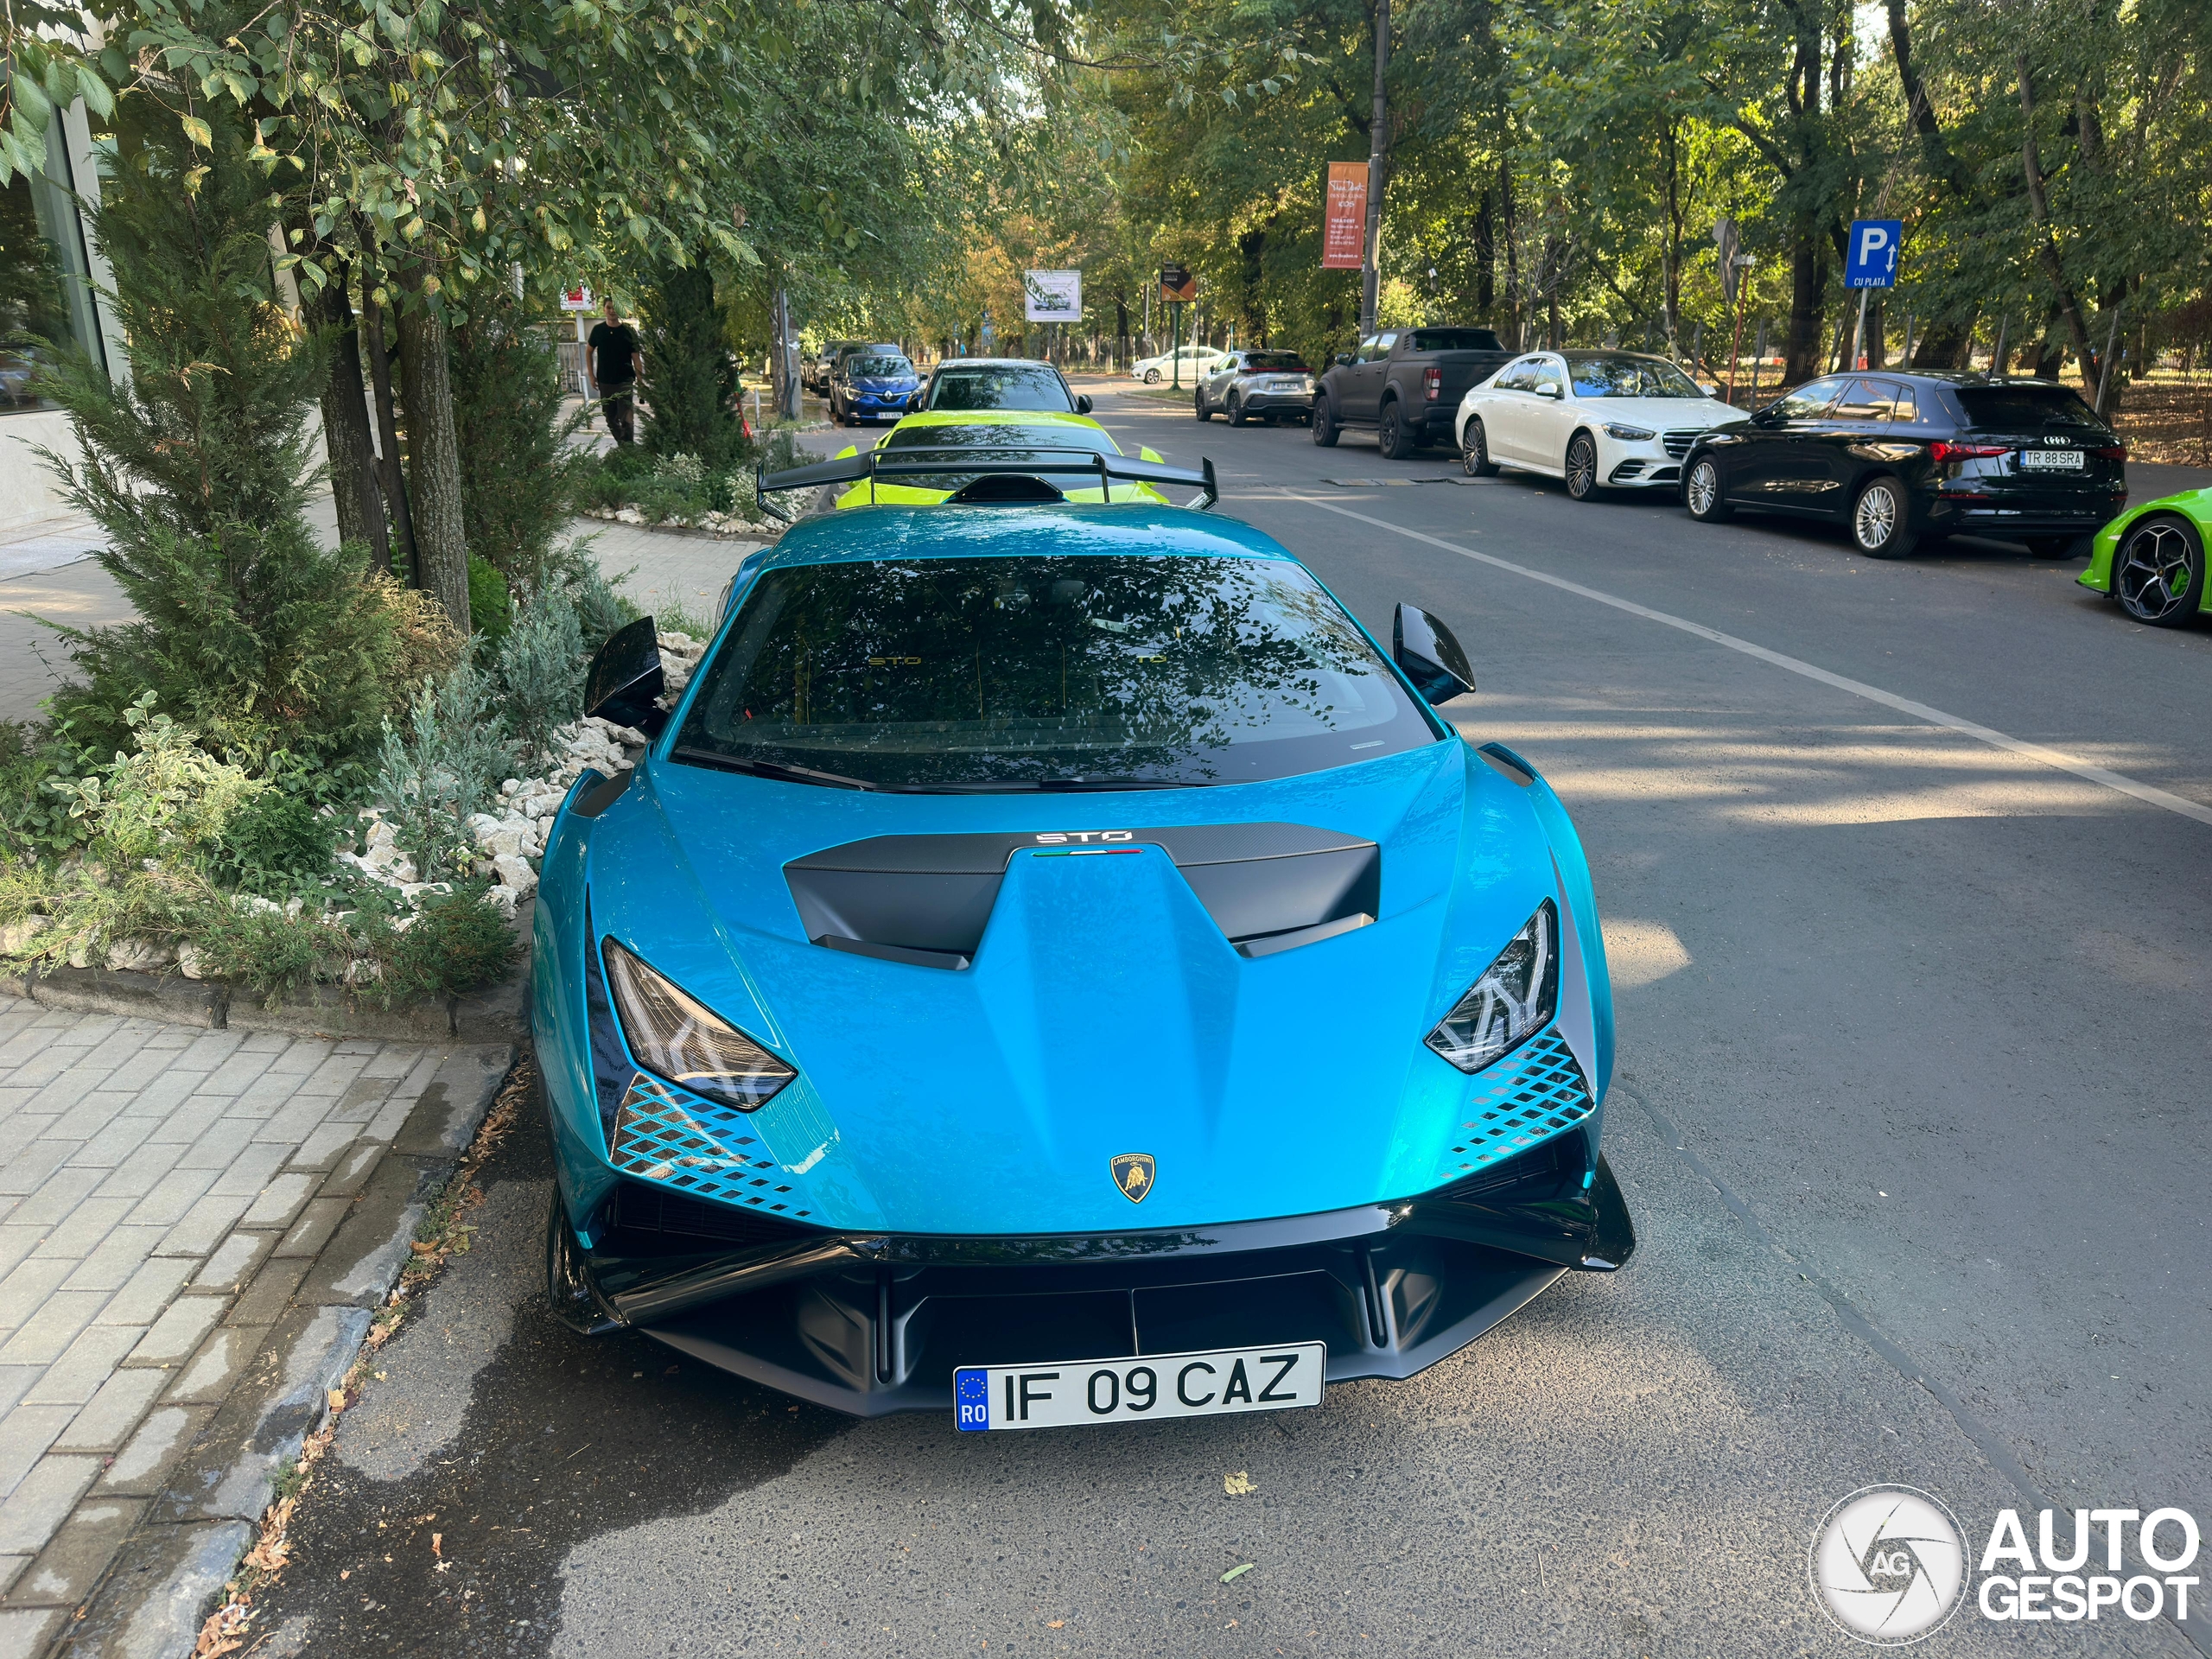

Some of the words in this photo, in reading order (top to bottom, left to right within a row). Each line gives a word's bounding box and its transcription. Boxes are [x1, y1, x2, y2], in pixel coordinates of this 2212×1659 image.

[1859, 228, 1888, 265] P
[1853, 277, 1864, 286] CU
[2027, 452, 2041, 463] TR
[2045, 452, 2057, 464] 88
[2059, 452, 2081, 464] SRA
[868, 657, 922, 665] STO
[1037, 831, 1133, 843] STO
[1114, 1155, 1151, 1166] LAMBORGHINI
[1005, 1372, 1060, 1421] IF
[1087, 1366, 1157, 1414] 09
[1177, 1353, 1300, 1408] CAZ
[961, 1404, 986, 1423] RO
